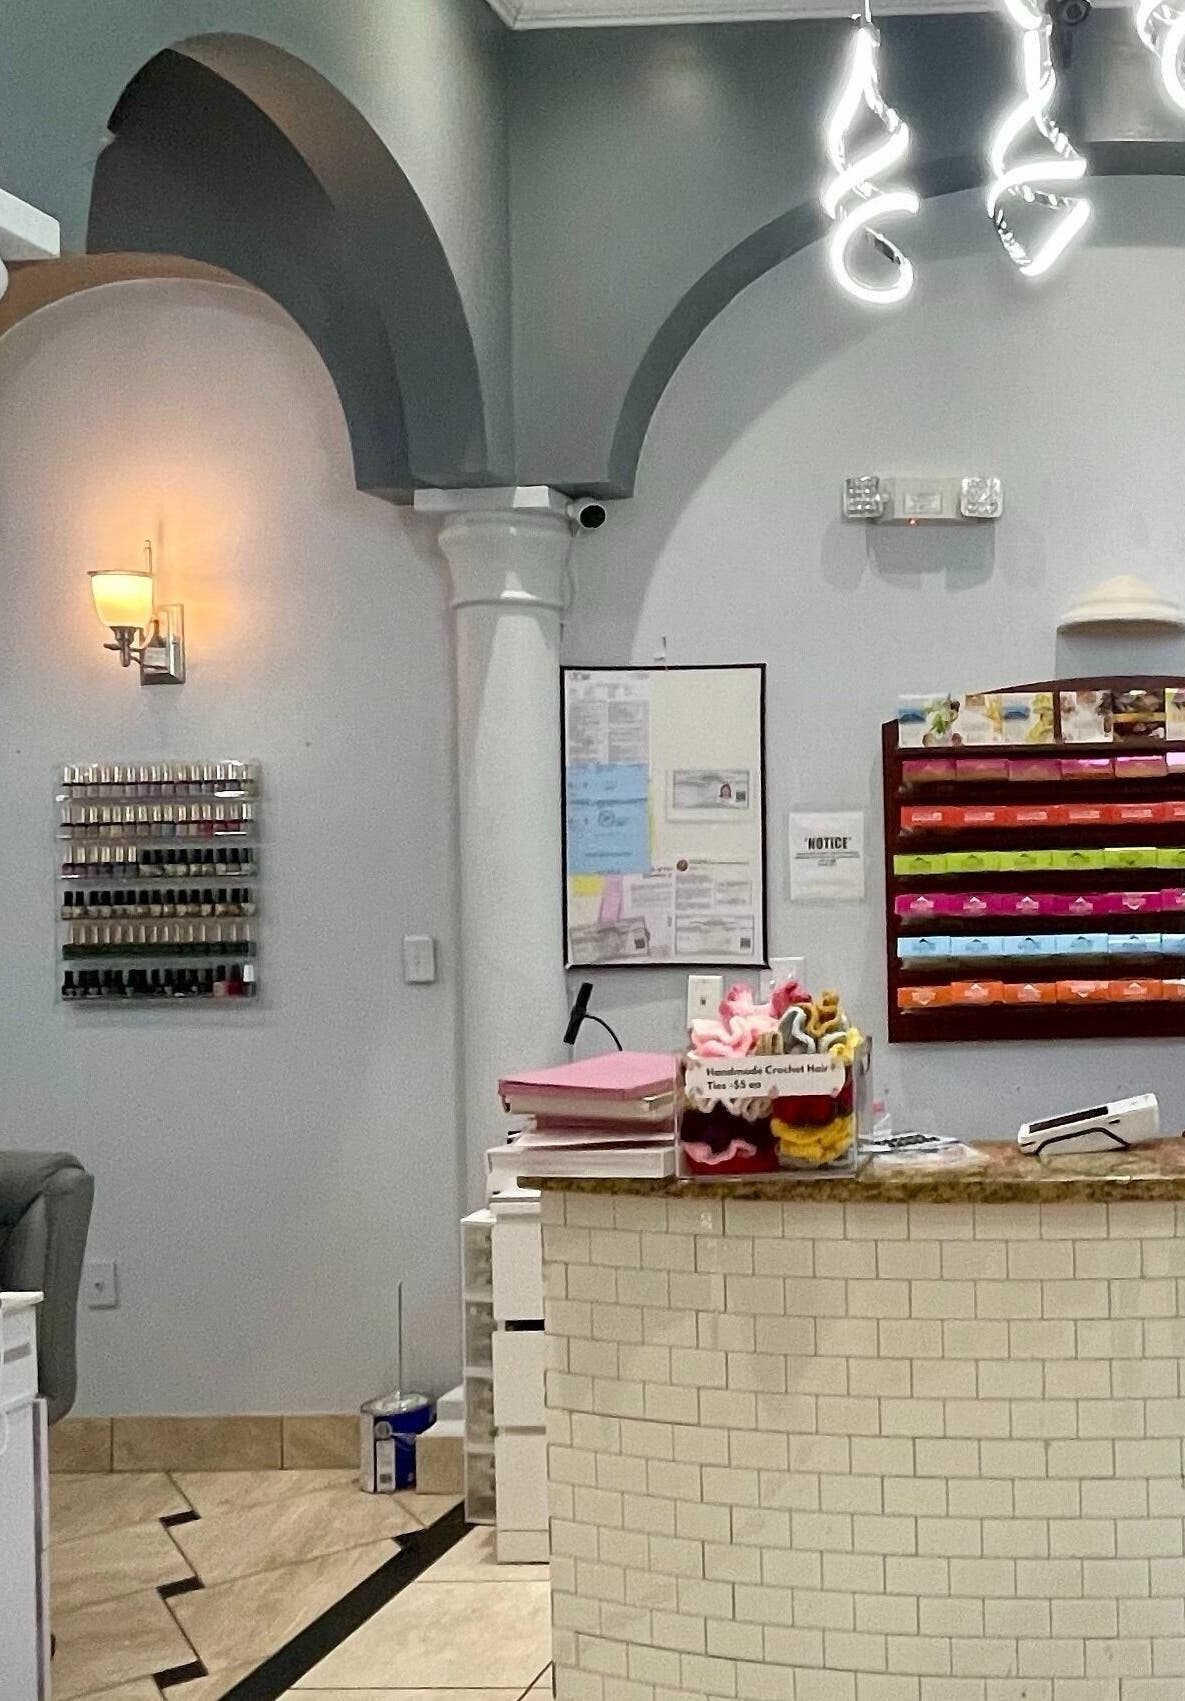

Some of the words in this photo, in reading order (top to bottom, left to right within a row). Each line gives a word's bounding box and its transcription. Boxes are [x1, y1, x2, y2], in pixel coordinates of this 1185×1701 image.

[706, 1065, 763, 1077] Handmade
[765, 1064, 805, 1075] Crochet
[807, 1063, 829, 1073] Hair
[706, 1080, 727, 1090] Ties
